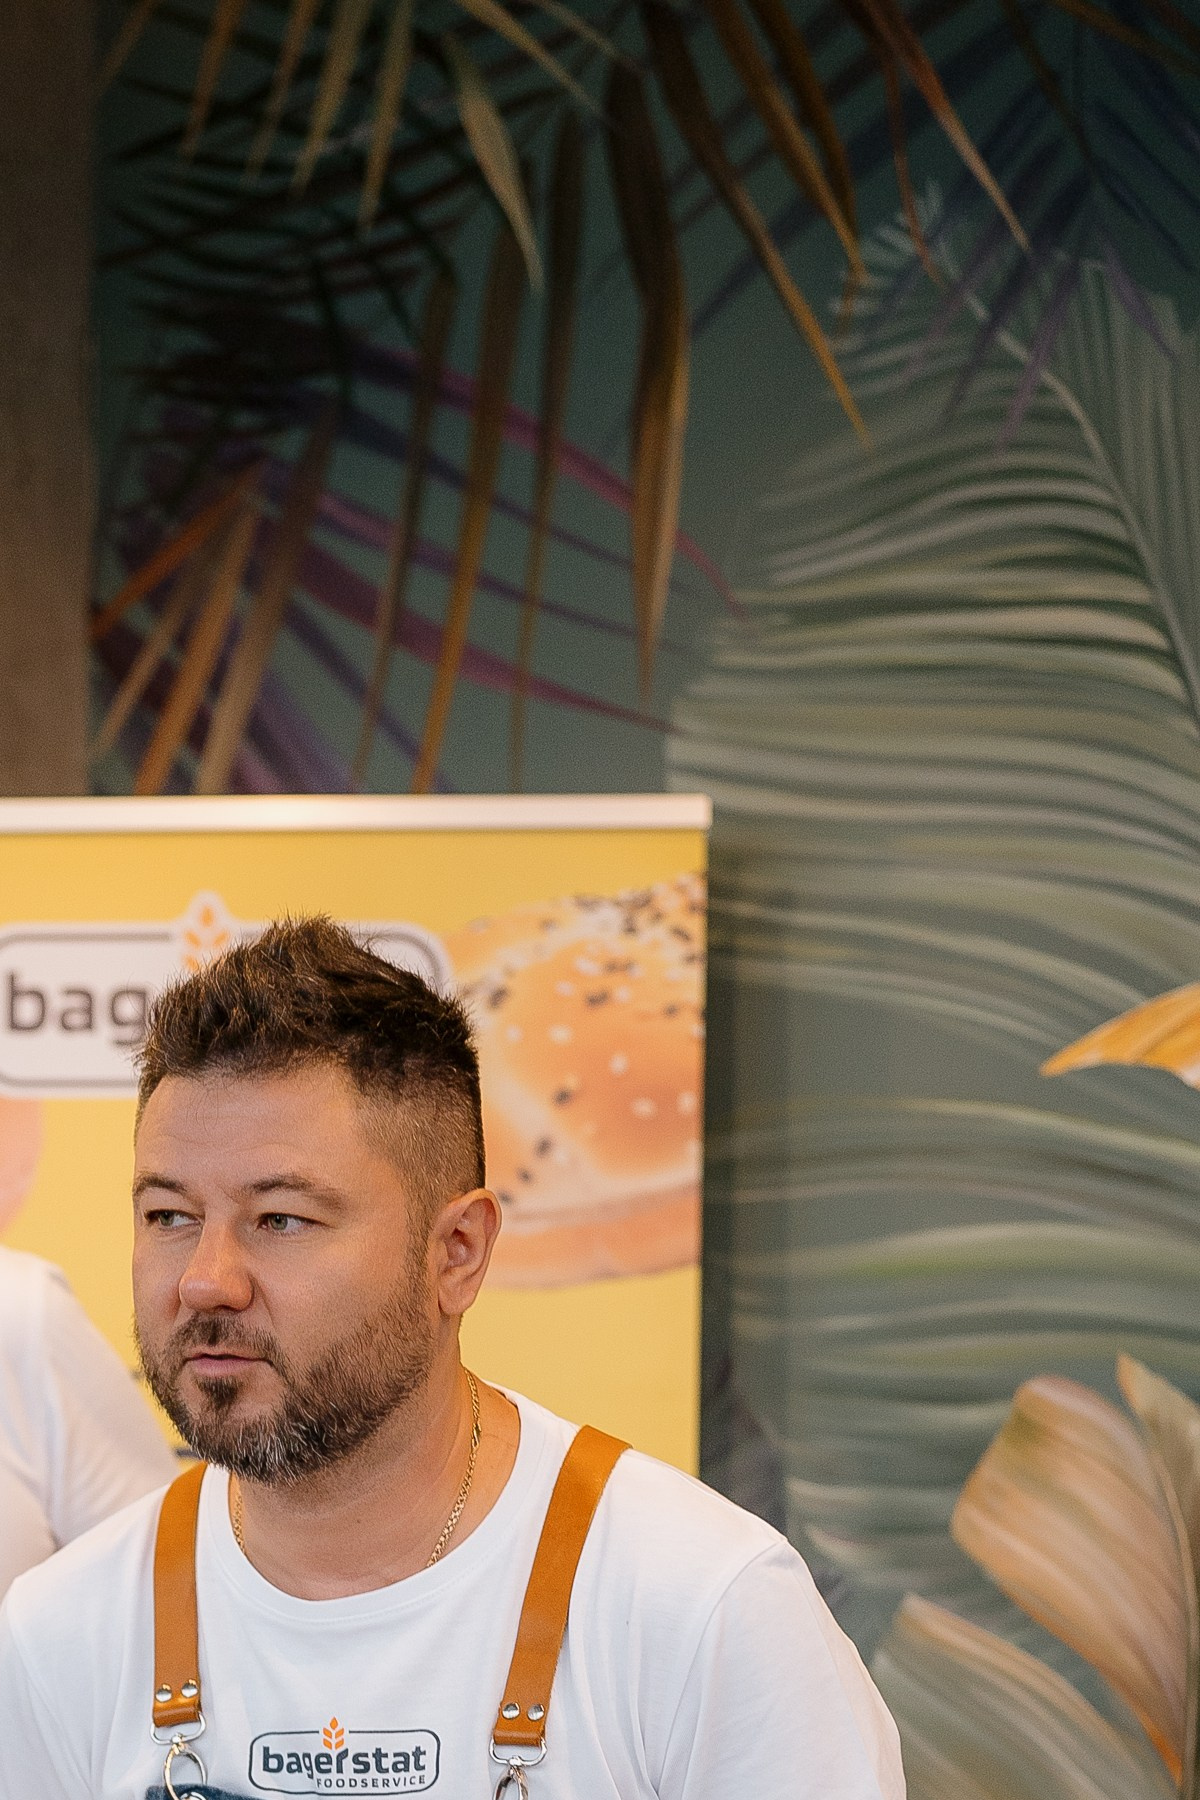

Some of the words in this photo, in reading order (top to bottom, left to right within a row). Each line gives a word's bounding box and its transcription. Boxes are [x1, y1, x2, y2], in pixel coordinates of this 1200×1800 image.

[5, 971, 149, 1047] bag
[261, 1745, 427, 1780] bagerstat
[316, 1774, 427, 1789] FOODSERVICE
